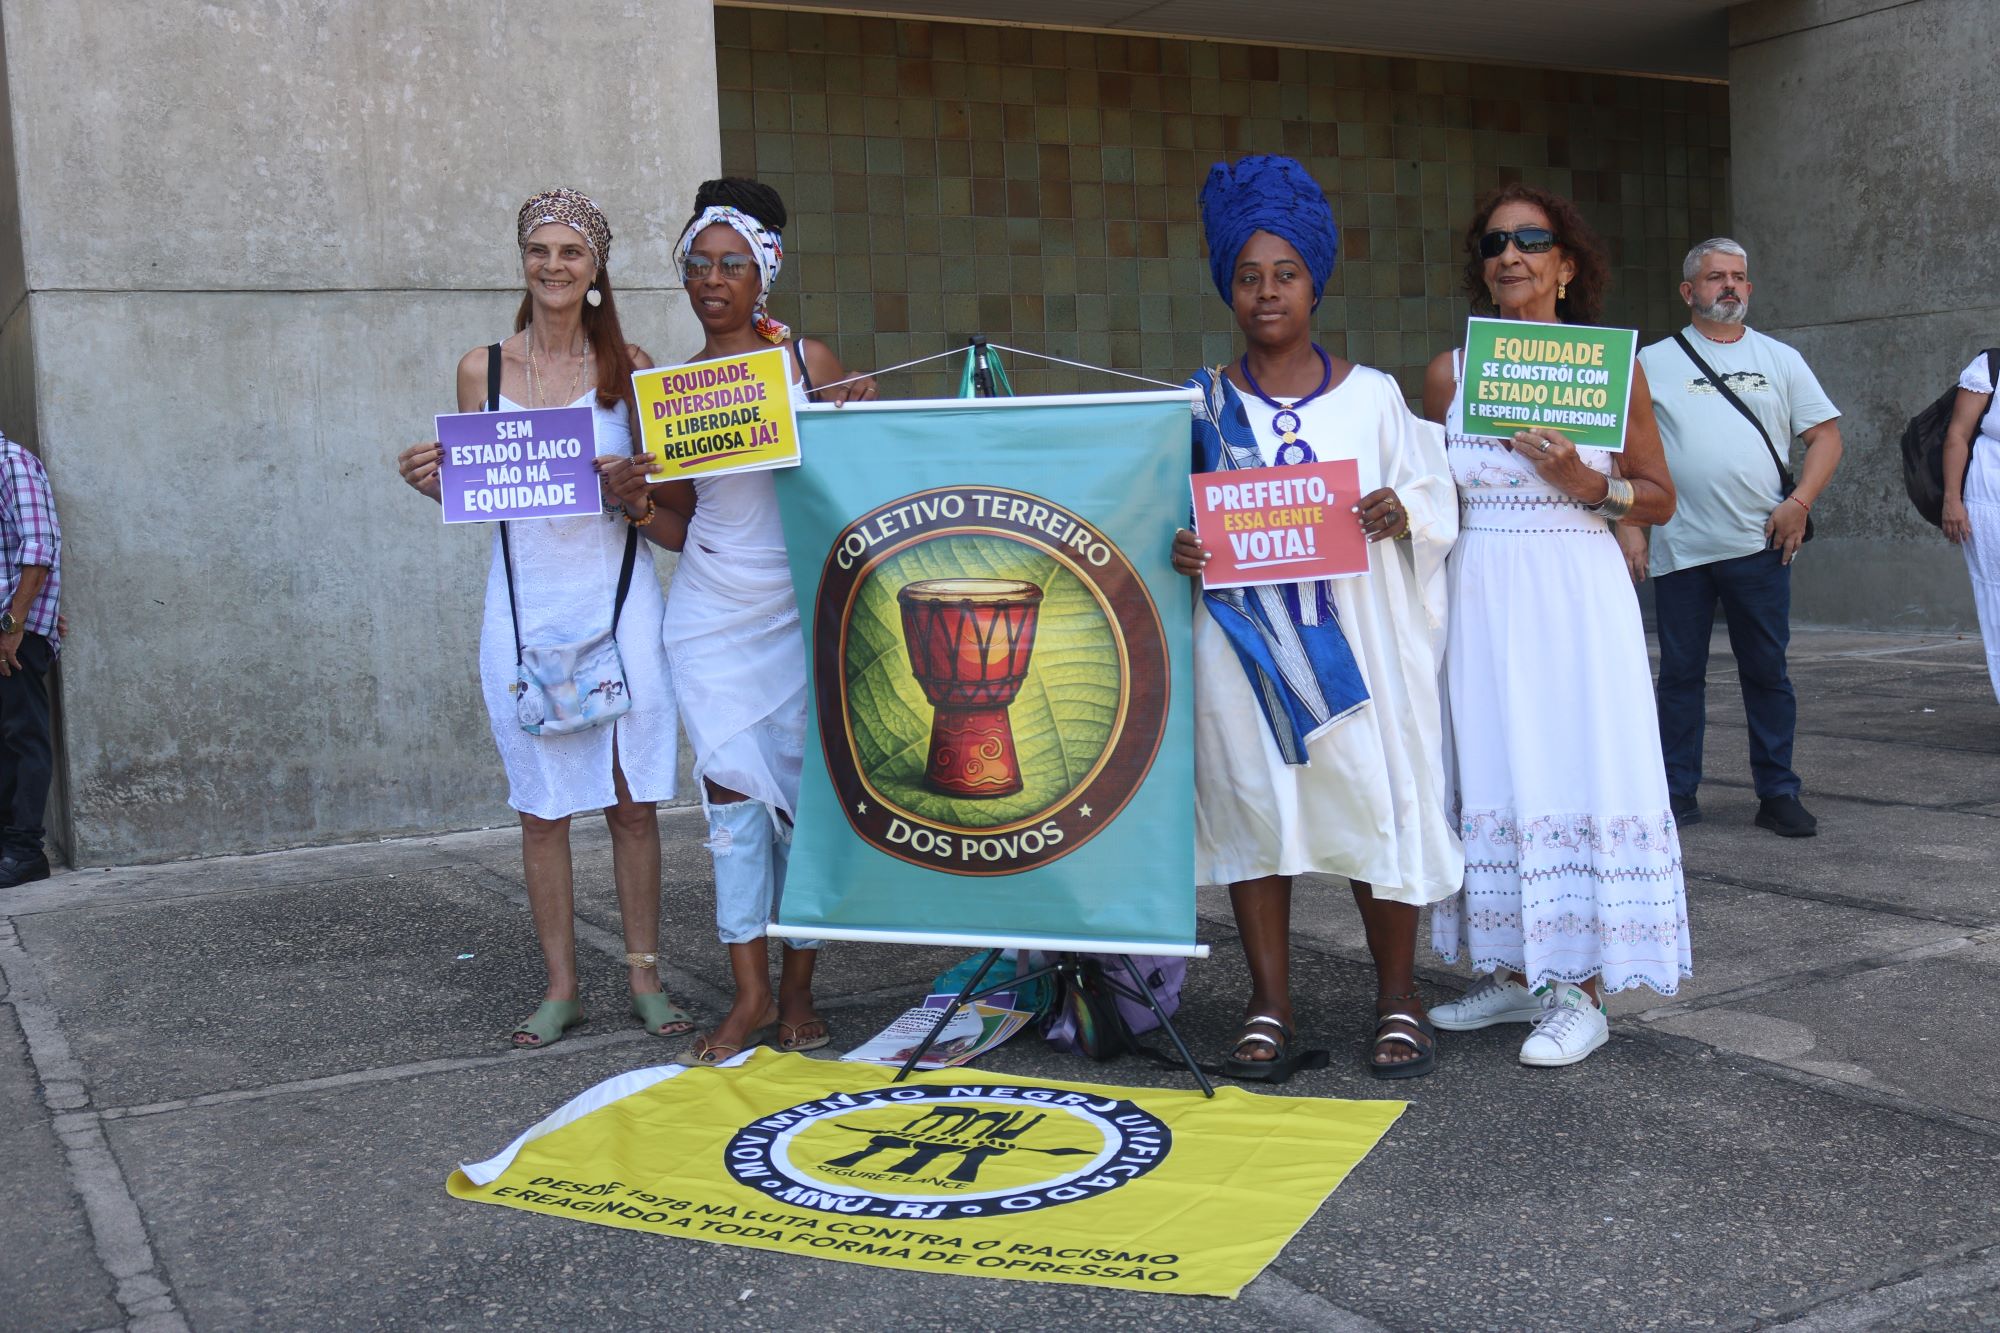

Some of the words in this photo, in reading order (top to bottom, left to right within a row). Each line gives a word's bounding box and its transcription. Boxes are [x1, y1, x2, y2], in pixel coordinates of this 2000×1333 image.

[1494, 337, 1605, 366] EQUIDADE
[662, 362, 755, 395] EQUIDADE,
[1481, 362, 1500, 378] SE
[1502, 364, 1573, 383] CONSTRÓI
[1577, 369, 1609, 385] COM
[653, 382, 767, 420] DIVERSIDADE
[1478, 380, 1548, 404] ESTADO
[1552, 386, 1607, 409] LAICO
[496, 420, 533, 440] SEM
[665, 424, 673, 438] E
[677, 406, 761, 436] LIBERDADE
[1470, 403, 1476, 416] E
[1479, 404, 1530, 421] RESPEITO
[1532, 405, 1541, 422] À
[1543, 408, 1616, 427] DIVERSIDADE
[451, 442, 521, 466] ESTADO
[526, 438, 581, 461] LAICO
[664, 431, 745, 460] RELIGIOSA
[749, 419, 779, 448] JÁ!
[486, 463, 522, 485] NÃO
[526, 461, 550, 482] HÁ
[464, 483, 577, 513] EQUIDADE
[1205, 476, 1335, 512] PREFEITO,
[837, 494, 965, 570] COLETIVO
[972, 495, 1112, 567] TERREIRO
[1224, 512, 1266, 531] ESSA
[1268, 506, 1324, 527] GENTE
[1229, 527, 1316, 561] VOTA!
[885, 818, 953, 858] DOS
[961, 821, 1065, 862] POVOS
[816, 1165, 888, 1181] SEGURE
[890, 1173, 902, 1182] E
[902, 1176, 969, 1190] LANCE
[1000, 1114, 1161, 1209] UNIFICADO
[492, 1186, 513, 1197] E
[512, 1189, 669, 1224] REAGINDO
[667, 1217, 692, 1228] A
[699, 1220, 784, 1242] TODA
[788, 1233, 911, 1259] FORMA
[918, 1251, 972, 1264] DE
[976, 1255, 1179, 1281] OPRESSÃO
[528, 1176, 625, 1196] DESDE
[627, 1189, 693, 1211] 1978
[693, 1204, 738, 1218] NA
[742, 1210, 819, 1228] LUTA
[826, 1222, 963, 1248] CONTRA
[972, 1240, 1002, 1250] O
[1005, 1243, 1179, 1264] RACISMO
